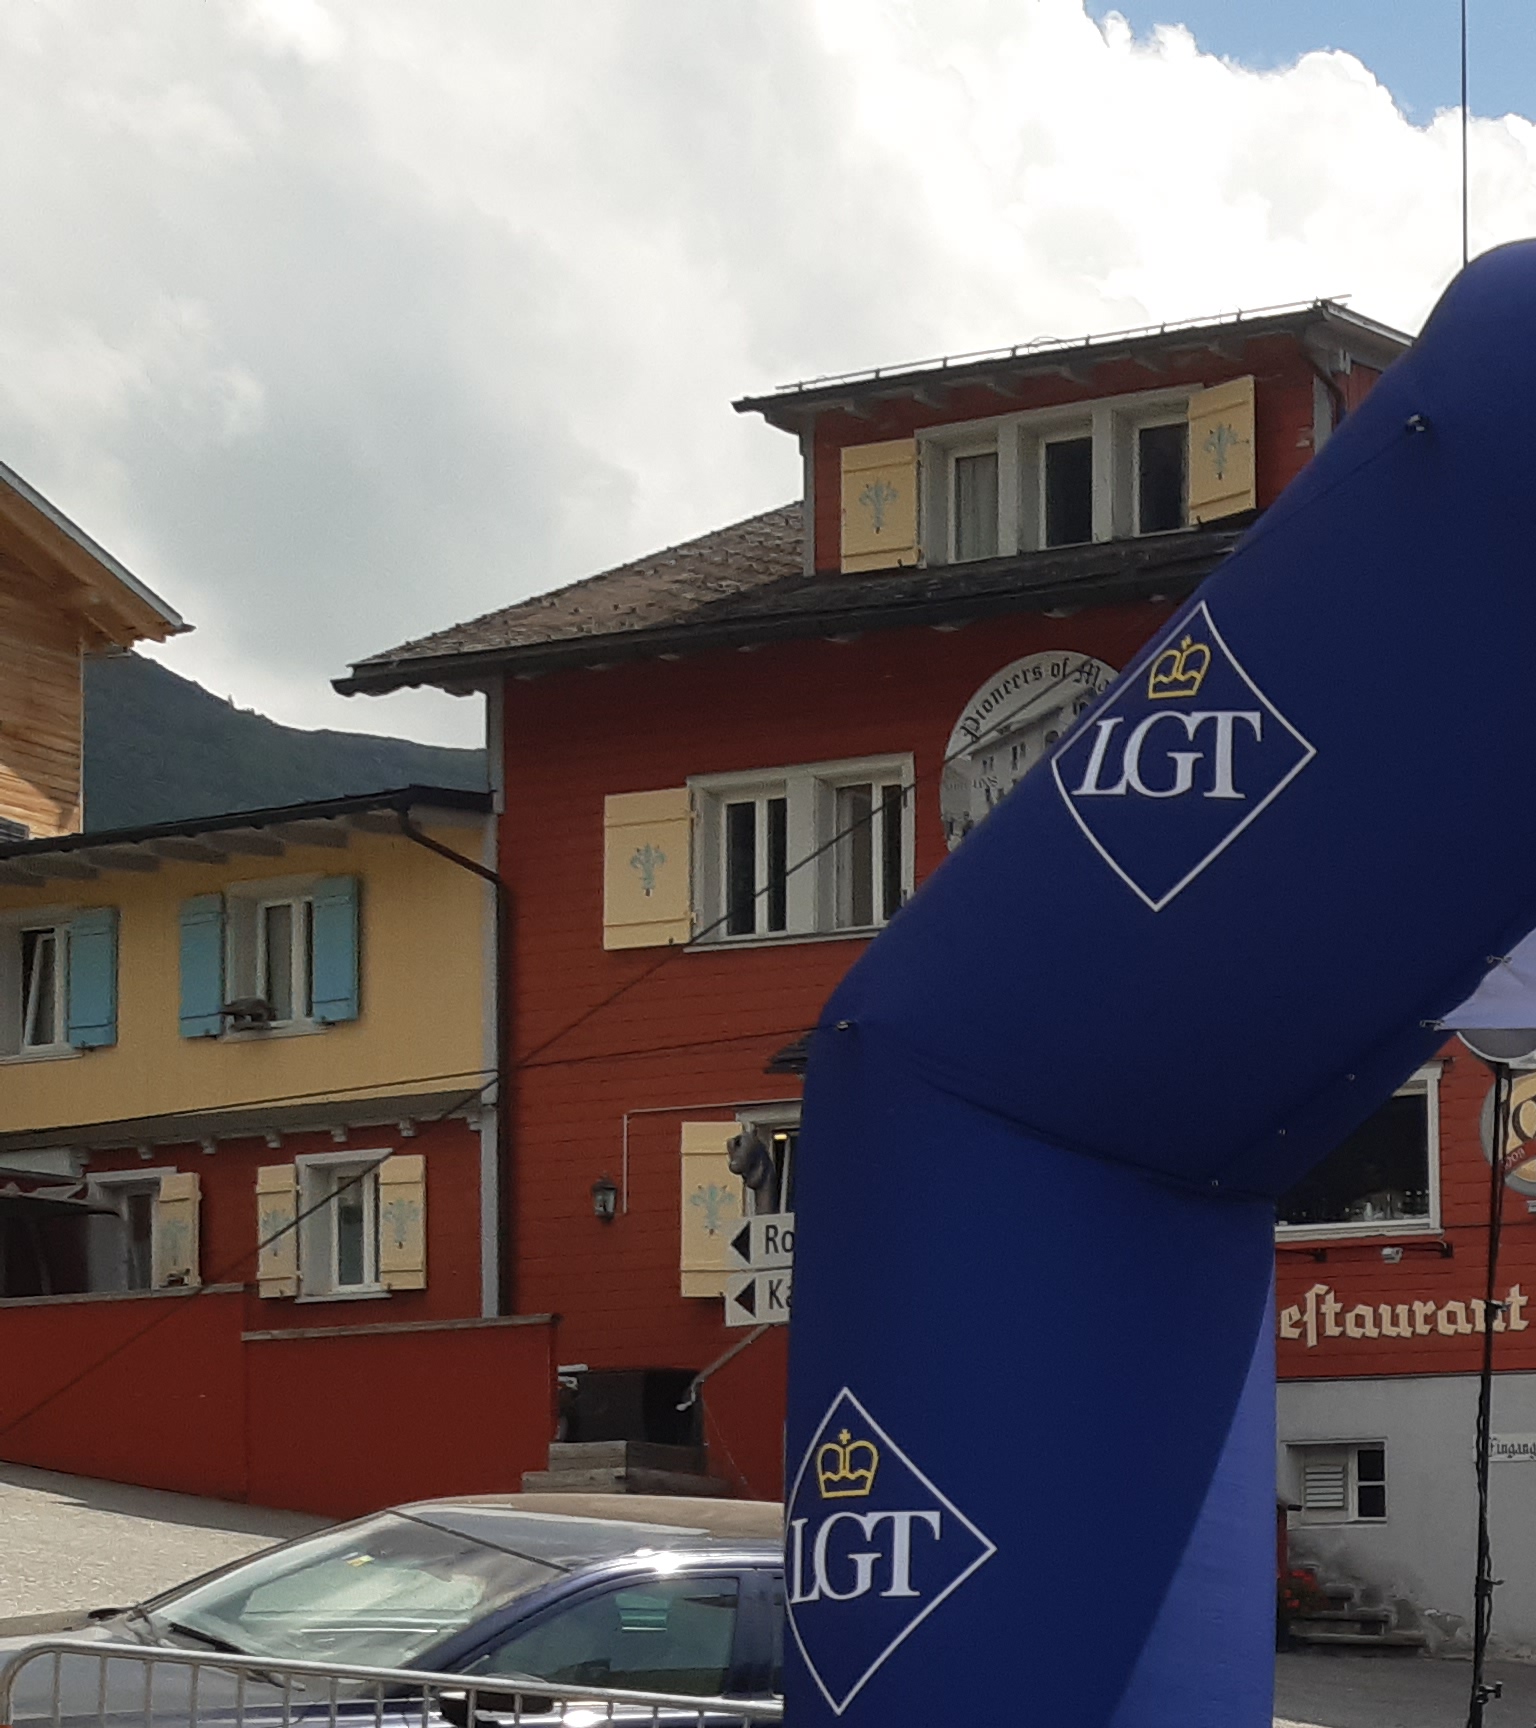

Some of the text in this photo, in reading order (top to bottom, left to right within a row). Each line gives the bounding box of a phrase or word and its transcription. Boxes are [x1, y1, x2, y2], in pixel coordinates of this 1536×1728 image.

[1073, 710, 1262, 799] LGT
[1280, 1283, 1529, 1347] estaurant
[790, 1511, 941, 1605] LGT
